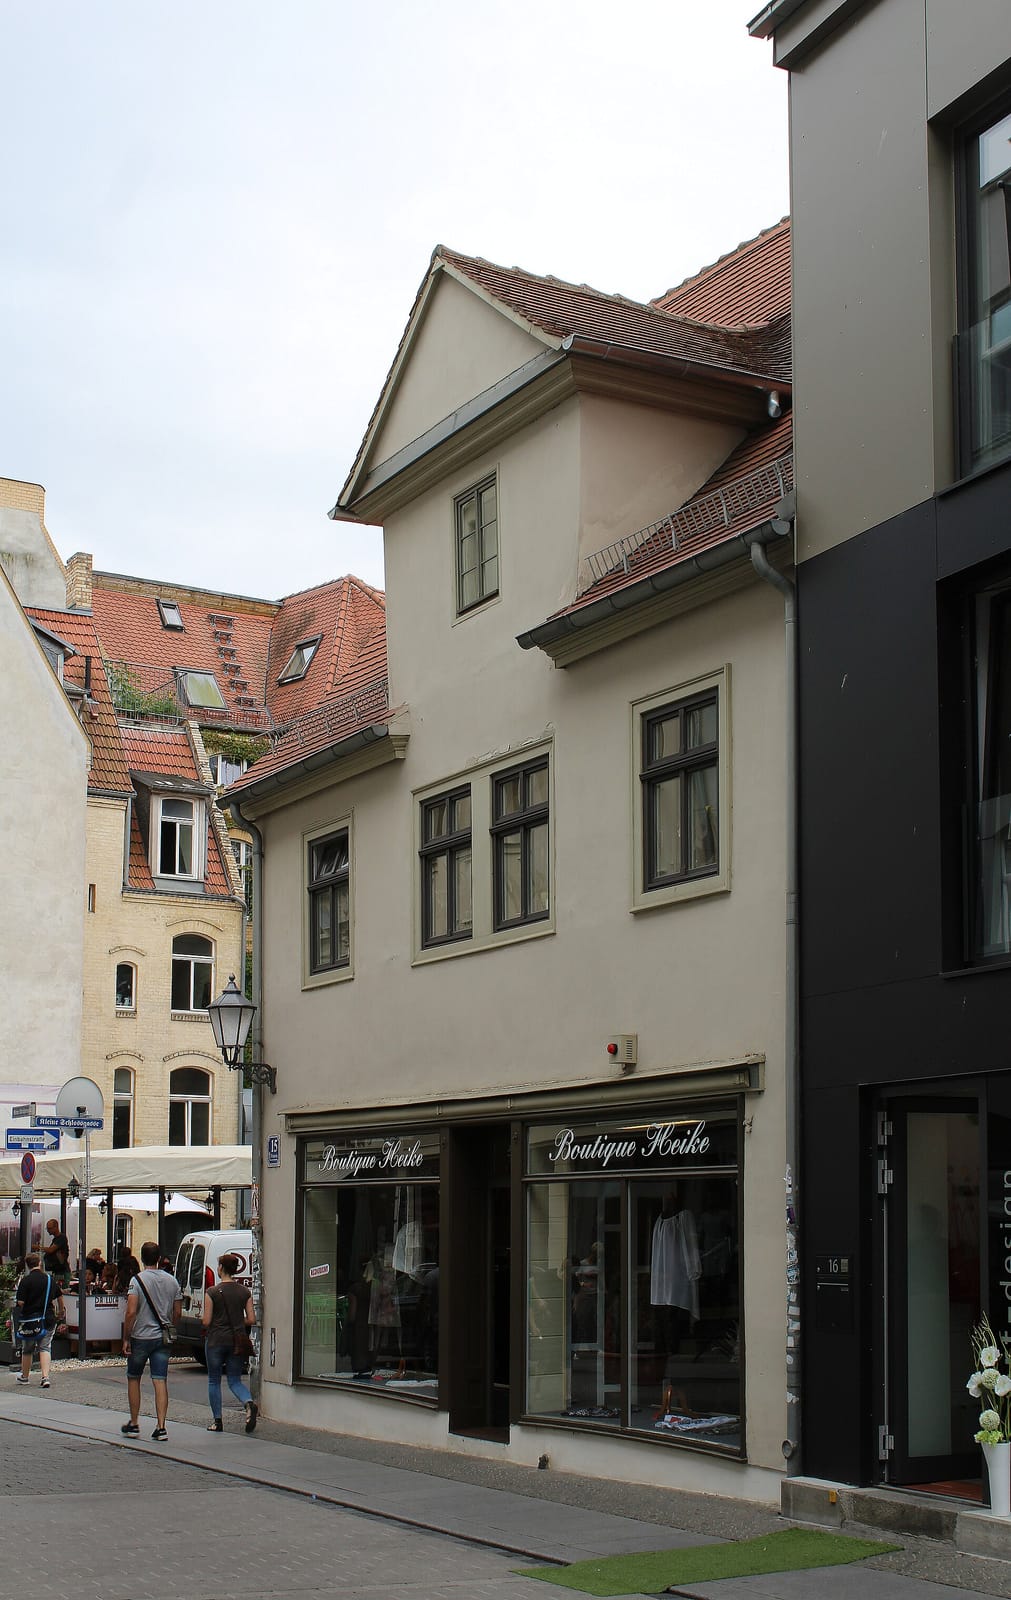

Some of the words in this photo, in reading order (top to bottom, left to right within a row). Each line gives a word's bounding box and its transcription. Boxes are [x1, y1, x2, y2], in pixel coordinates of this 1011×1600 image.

[271, 1139, 278, 1153] 15
[549, 1128, 636, 1167] Boutique
[641, 1120, 711, 1157] Heike
[318, 1144, 376, 1177] Boutique
[378, 1139, 423, 1169] Heike
[829, 1258, 839, 1273] 16
